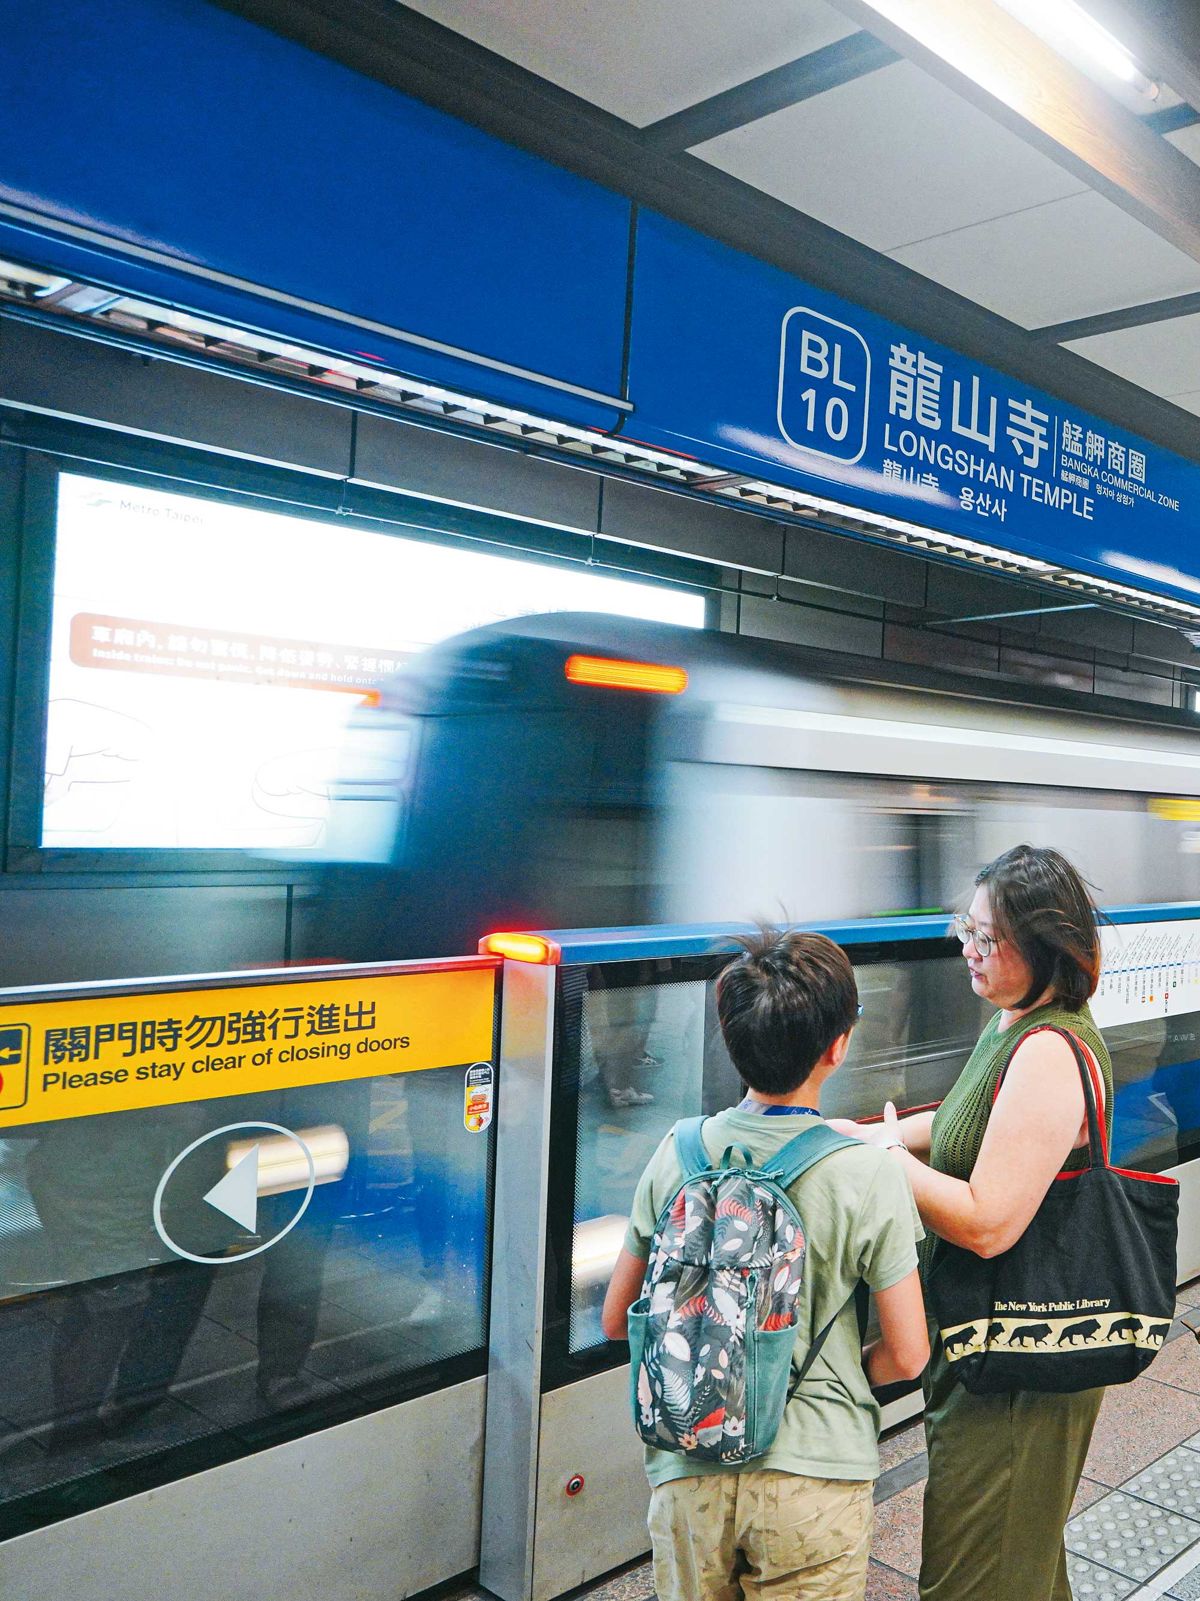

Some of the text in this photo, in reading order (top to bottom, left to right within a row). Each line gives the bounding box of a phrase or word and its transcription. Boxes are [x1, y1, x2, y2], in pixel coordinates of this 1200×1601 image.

[800, 330, 856, 392] BL
[801, 388, 848, 441] 10
[888, 343, 1049, 469] 龍山寺
[884, 423, 1095, 520] LONGSHAN TEMPLE
[1062, 419, 1146, 483] 艋舺商圈
[119, 499, 160, 517] Metro
[959, 486, 1008, 522] 용산사
[1061, 454, 1180, 511] BANGKA COMMERCIAL ZONE
[309, 671, 328, 681] and
[330, 672, 353, 683] hold
[43, 1001, 376, 1066] 關門時勿強行進出
[42, 1036, 410, 1092] Please stay clear of closing doors
[994, 1299, 1111, 1312] The New York Public Library
